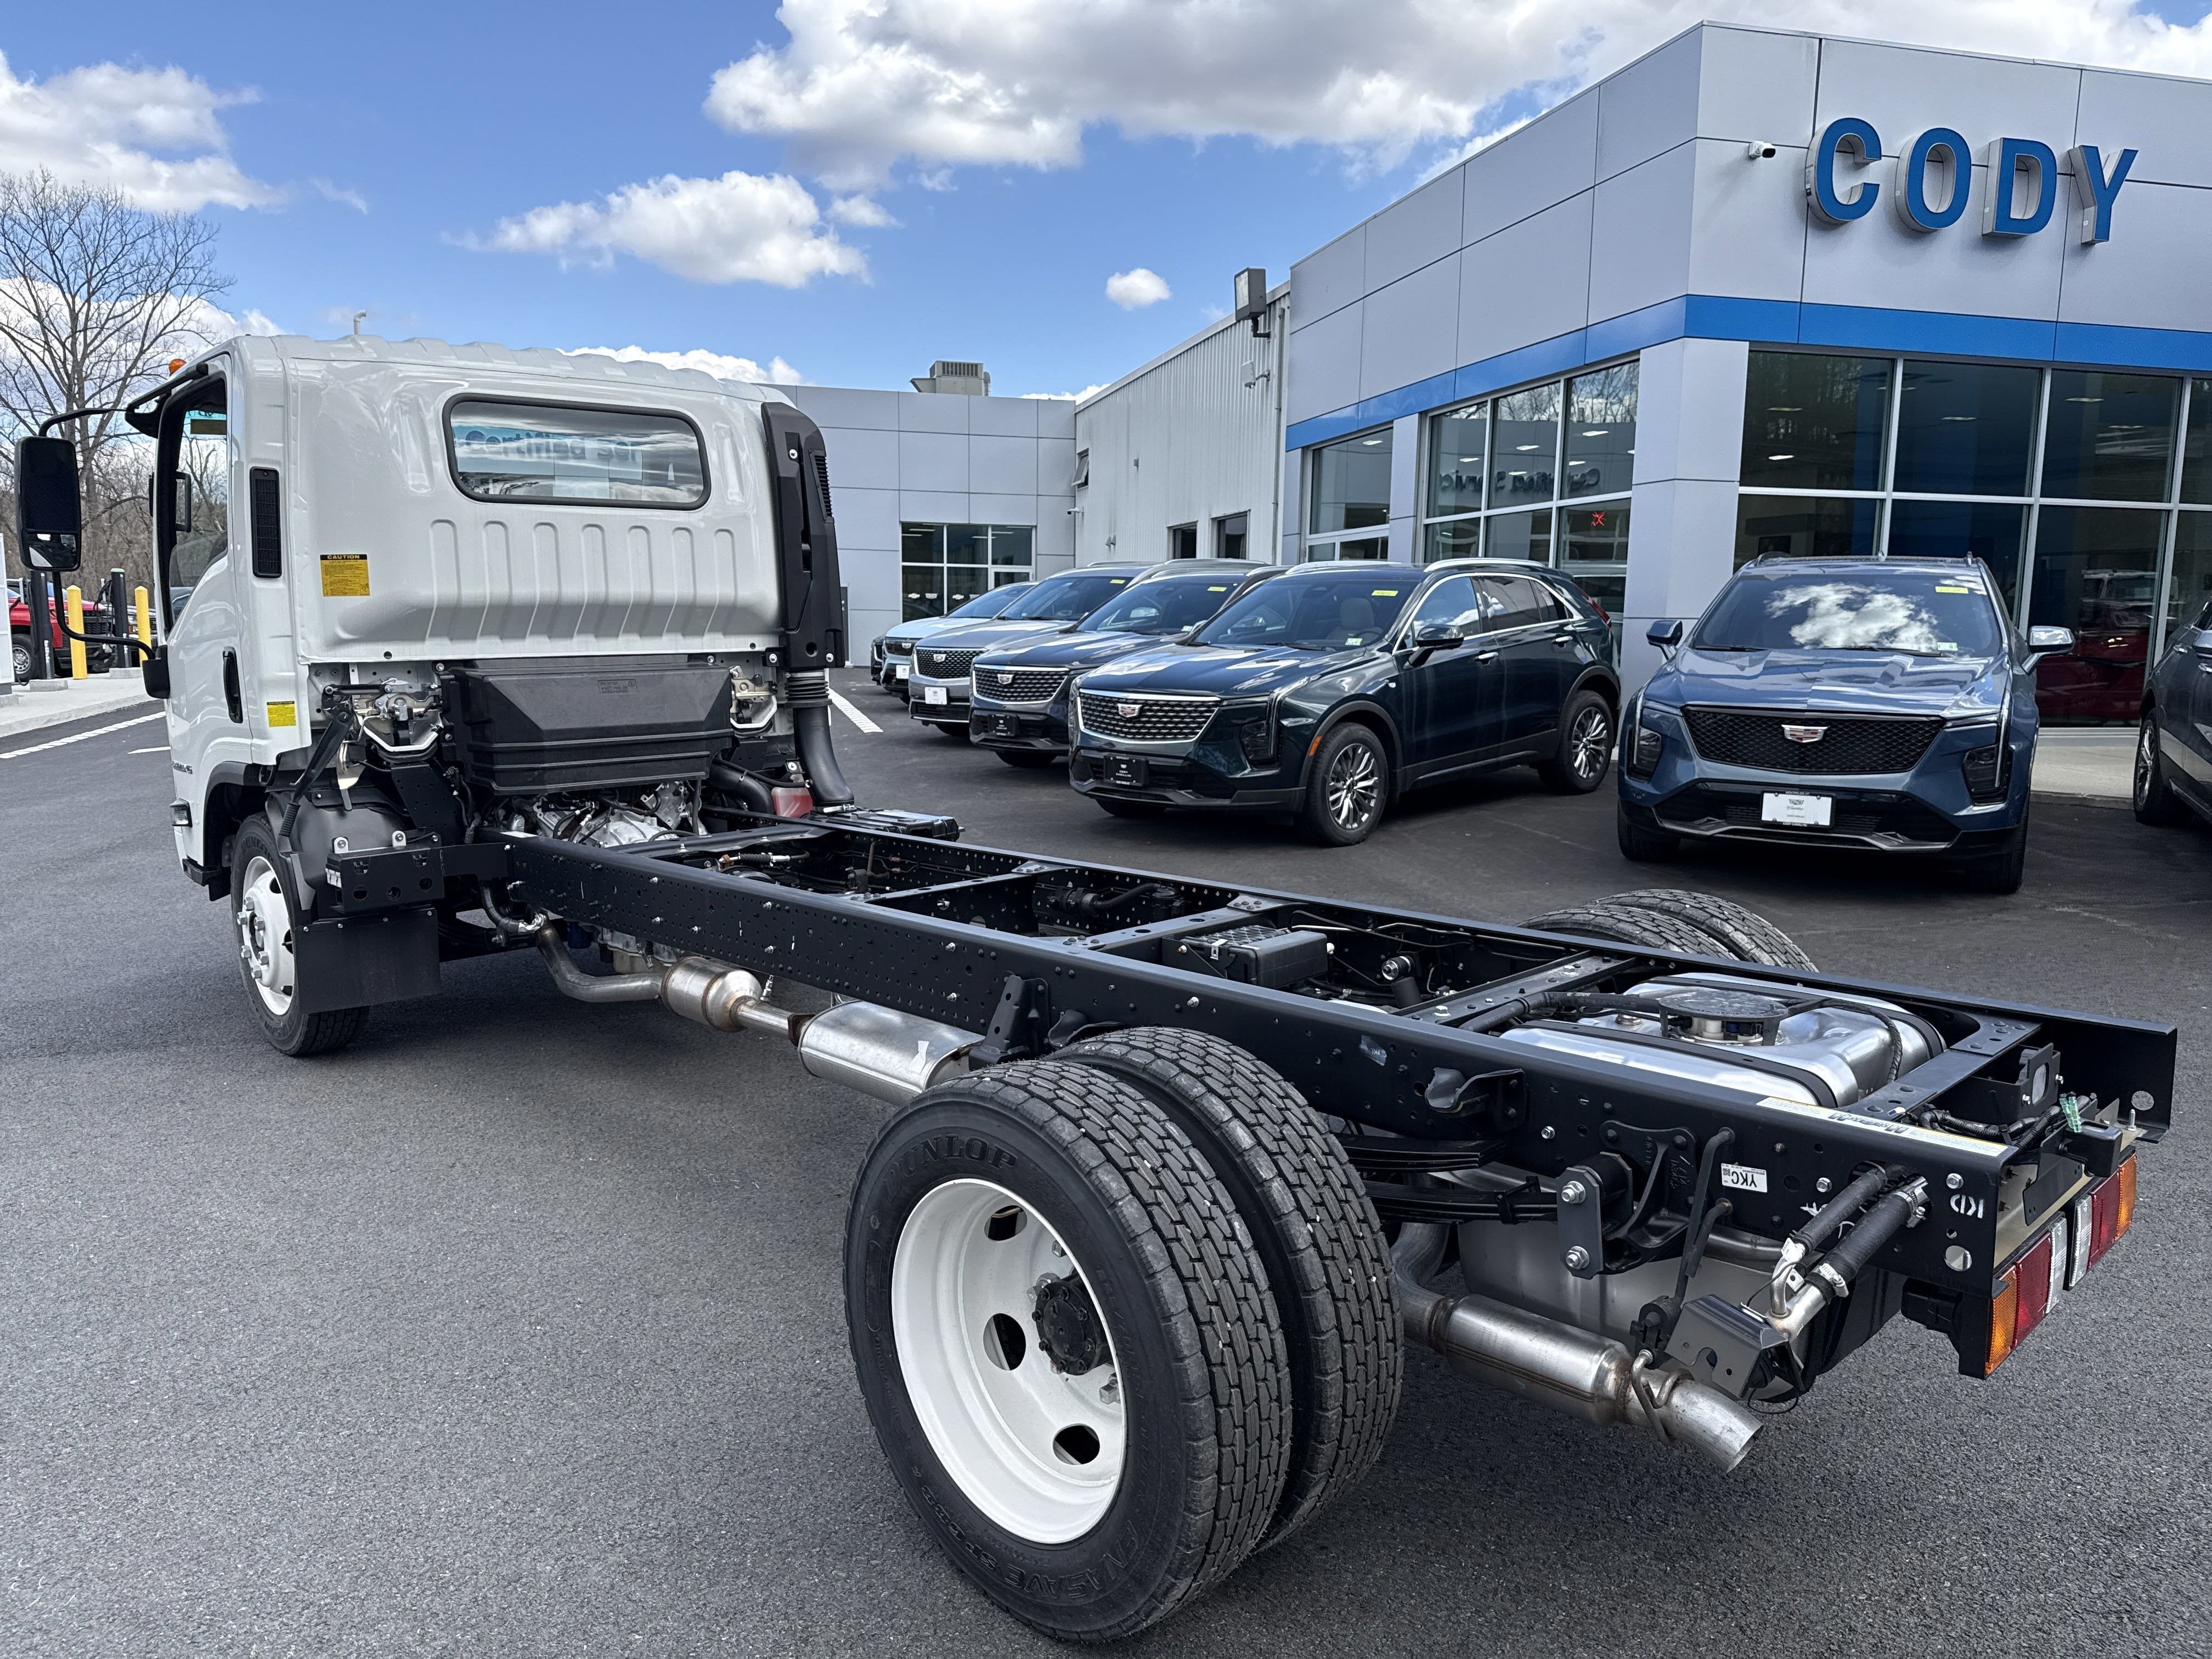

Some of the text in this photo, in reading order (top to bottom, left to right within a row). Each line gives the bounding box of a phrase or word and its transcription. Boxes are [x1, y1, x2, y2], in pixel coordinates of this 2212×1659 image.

[1807, 117, 2138, 245] CODY
[465, 430, 586, 460] Certified
[884, 1133, 1019, 1204] DUNLOP
[1731, 1171, 1758, 1188] YKC
